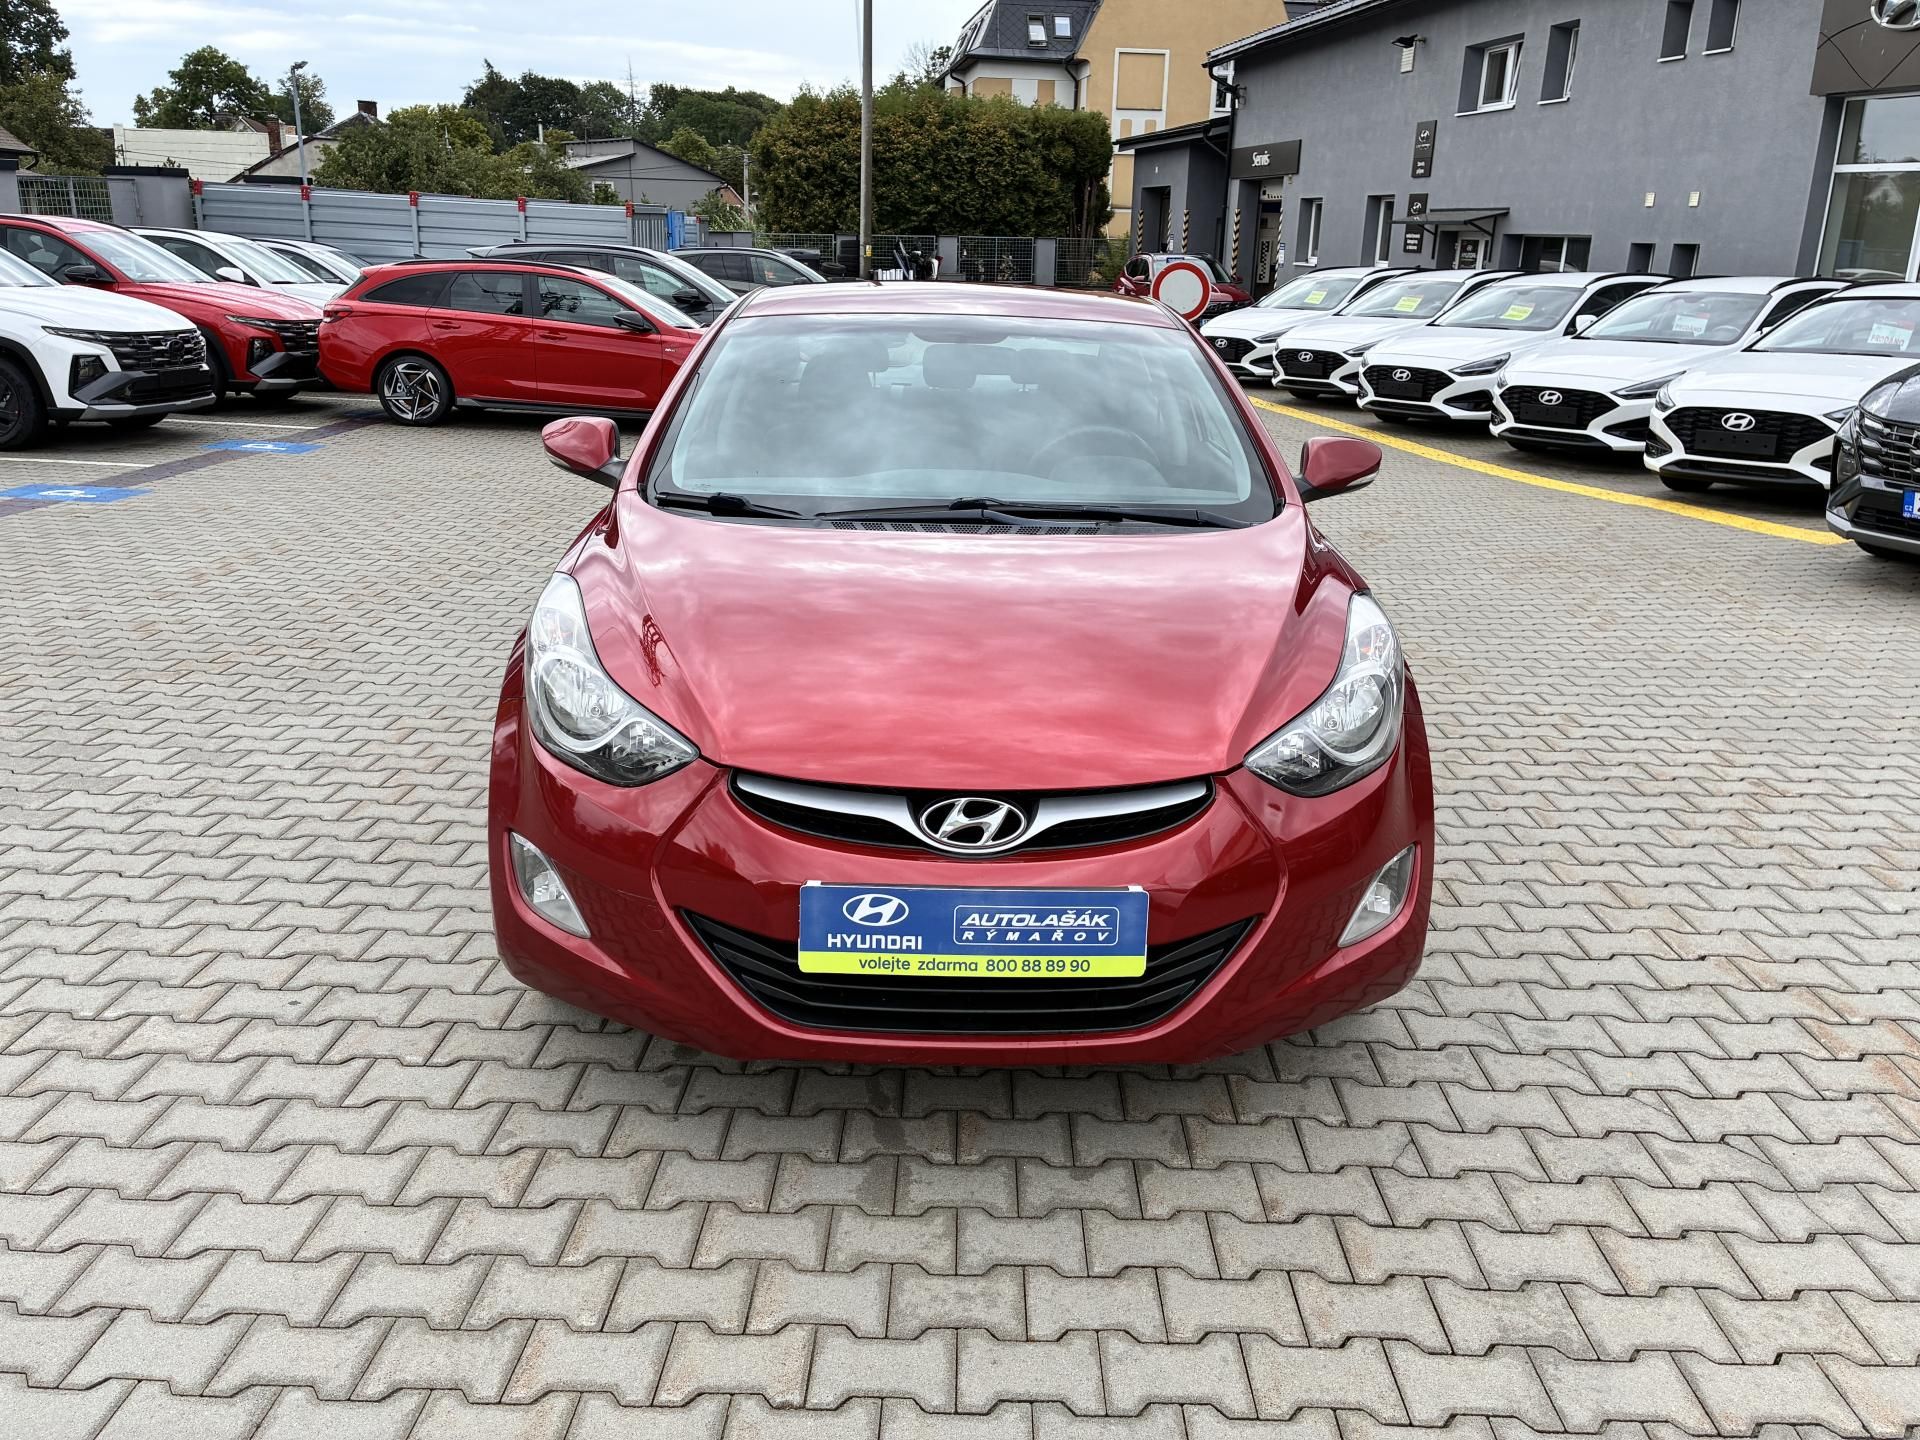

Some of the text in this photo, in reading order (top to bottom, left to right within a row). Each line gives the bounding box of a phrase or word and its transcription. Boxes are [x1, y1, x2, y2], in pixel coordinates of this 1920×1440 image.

[962, 910, 1110, 927] AUTOLAŠÁK
[827, 933, 922, 950] HYUNDAI
[962, 929, 1109, 941] RÝMAŘOV
[859, 956, 1090, 973] volejte zdarma 800 88 89 90
